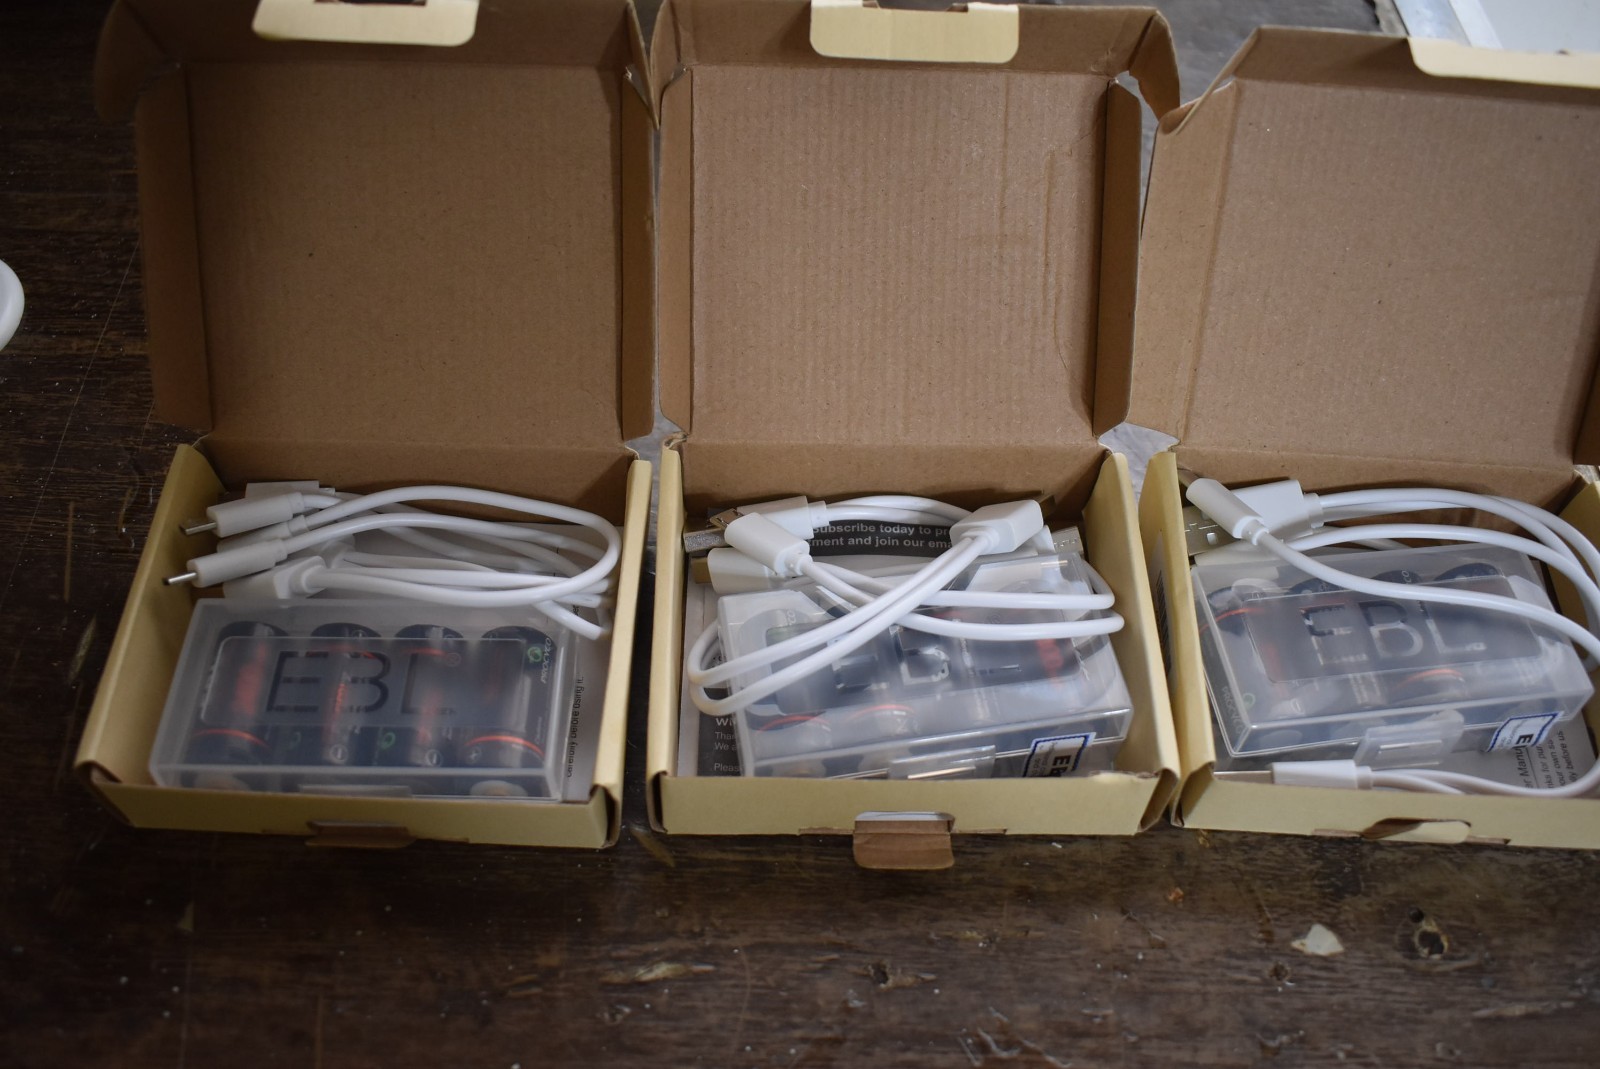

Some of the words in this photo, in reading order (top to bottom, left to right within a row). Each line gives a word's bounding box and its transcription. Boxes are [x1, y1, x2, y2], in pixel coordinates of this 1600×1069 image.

[847, 536, 872, 545] and
[875, 536, 899, 547] join
[879, 524, 915, 536] today
[918, 526, 931, 534] to
[935, 528, 950, 537] pr
[1301, 600, 1487, 666] EBL
[266, 651, 457, 714] EBL
[1550, 751, 1561, 769] own
[1560, 743, 1574, 770] before
